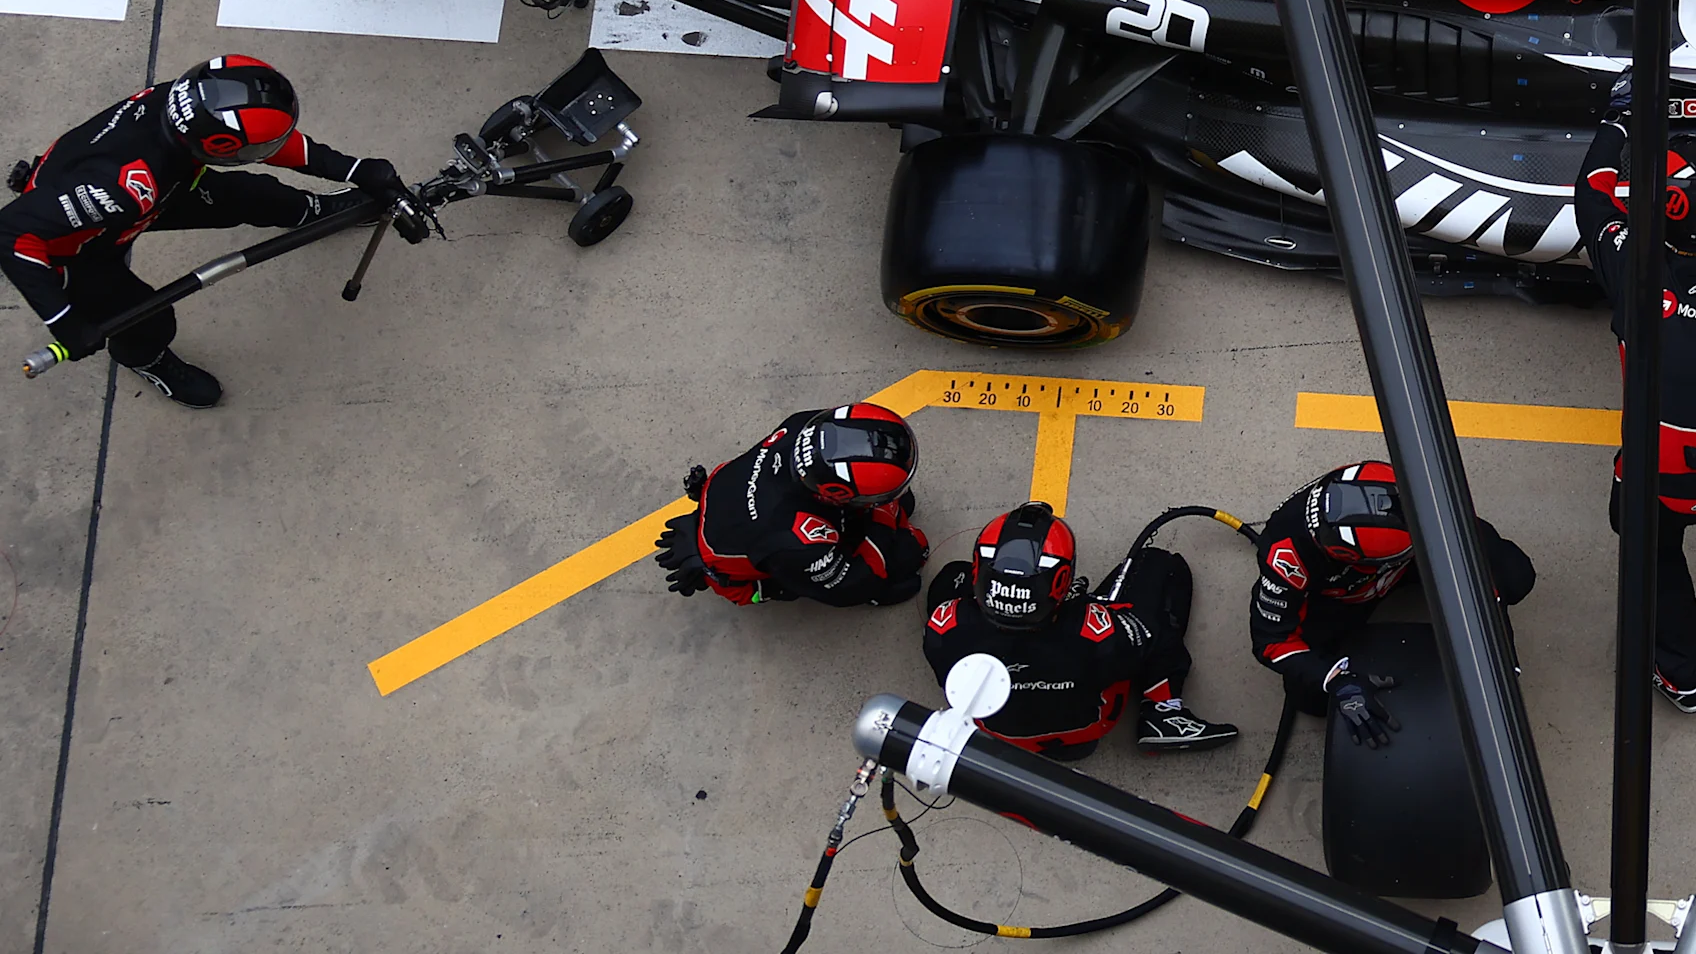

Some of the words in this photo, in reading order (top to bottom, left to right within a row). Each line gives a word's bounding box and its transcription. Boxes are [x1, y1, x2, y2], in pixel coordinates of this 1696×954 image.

[87, 184, 124, 214] HAAS
[58, 193, 83, 228] PIRELLI
[943, 391, 961, 404] 30
[978, 393, 997, 406] 20
[1017, 395, 1031, 408] 10
[1088, 400, 1102, 412] 10
[1122, 402, 1140, 415] 20
[1156, 405, 1175, 417] 30
[746, 447, 769, 521] MoneyGram
[804, 546, 836, 573] HAAS
[989, 579, 1031, 600] Palm
[985, 593, 1037, 615] Angels
[1010, 680, 1075, 691] neyGram
